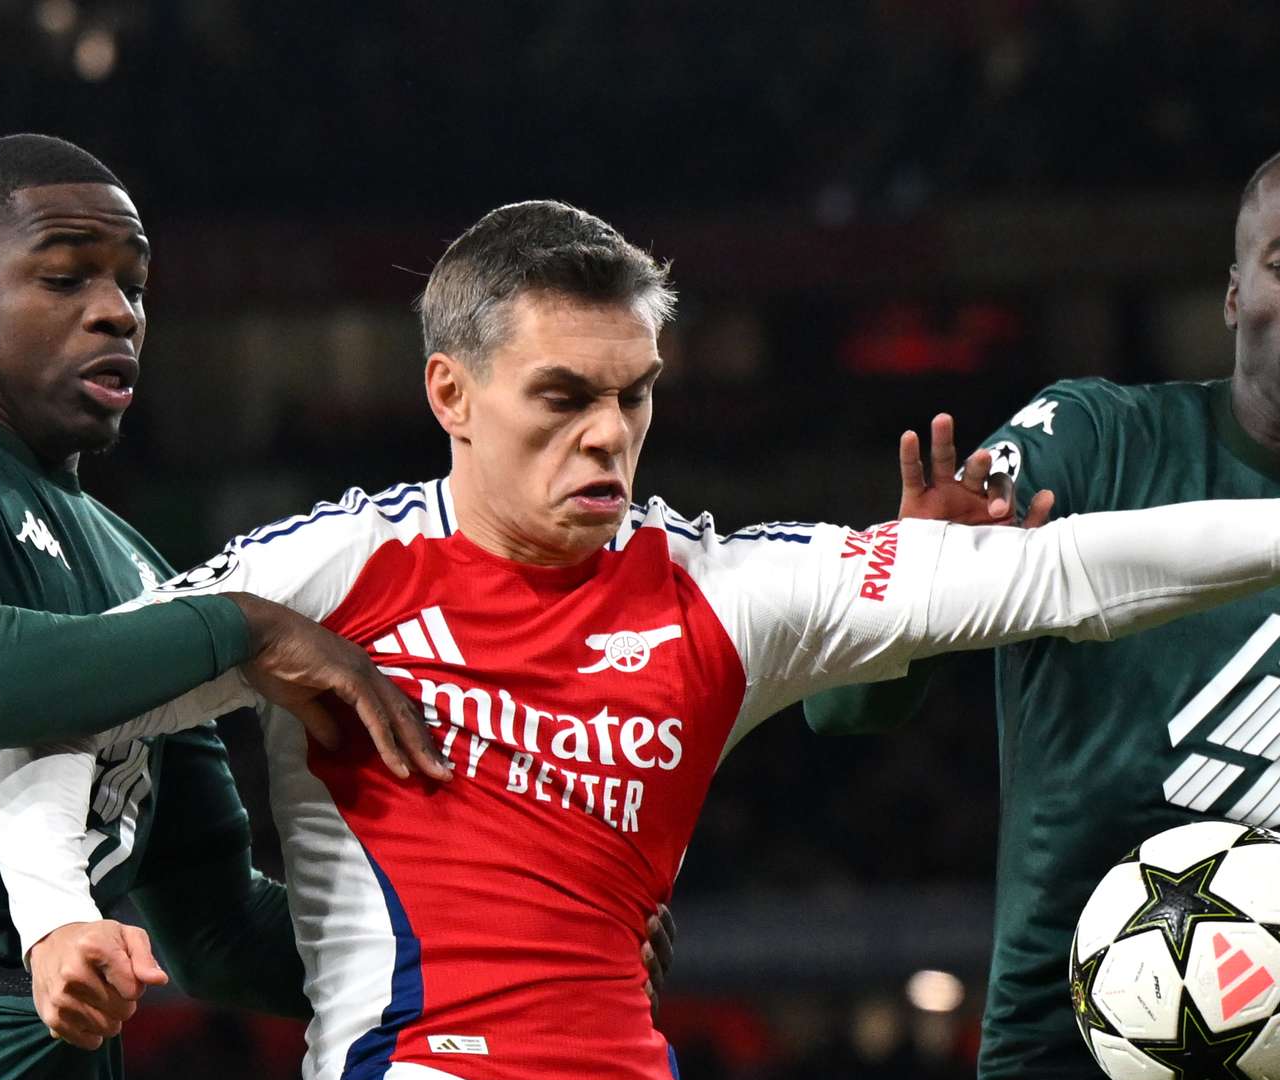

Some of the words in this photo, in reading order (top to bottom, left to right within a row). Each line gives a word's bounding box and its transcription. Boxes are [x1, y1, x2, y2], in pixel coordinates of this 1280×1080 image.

[441, 726, 490, 779] LY
[506, 752, 645, 833] BETTER
[1153, 975, 1162, 1000] PRO
